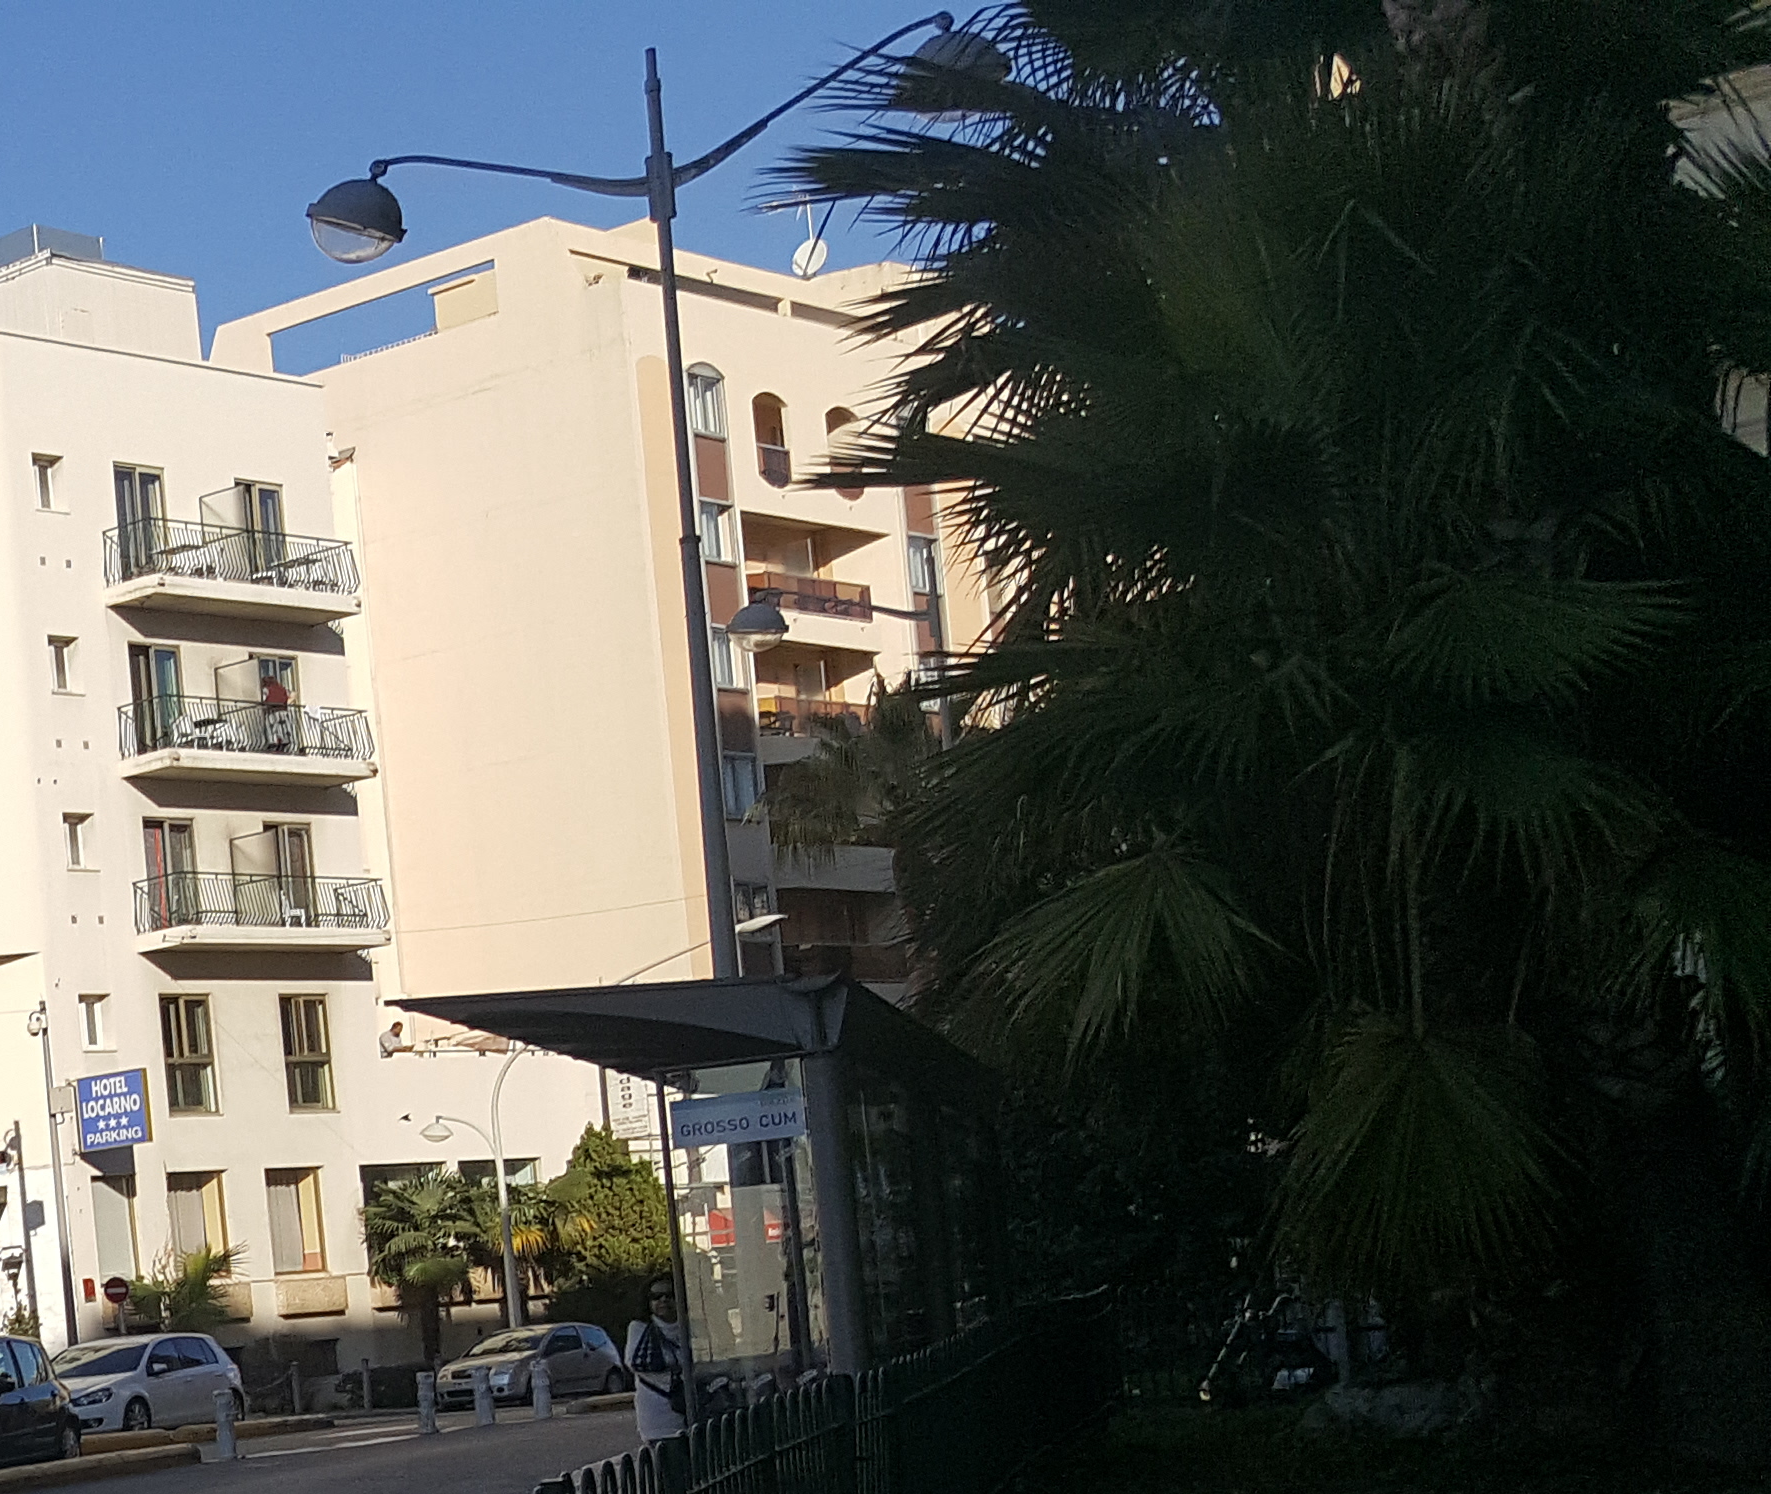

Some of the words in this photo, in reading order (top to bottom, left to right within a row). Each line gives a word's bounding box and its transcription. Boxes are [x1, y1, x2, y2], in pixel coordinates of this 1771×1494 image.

[91, 1076, 128, 1098] HOTEL
[82, 1094, 140, 1119] LOCARNO
[680, 1117, 750, 1138] GROSSO
[759, 1110, 797, 1128] CUM
[86, 1126, 142, 1146] PARKING
